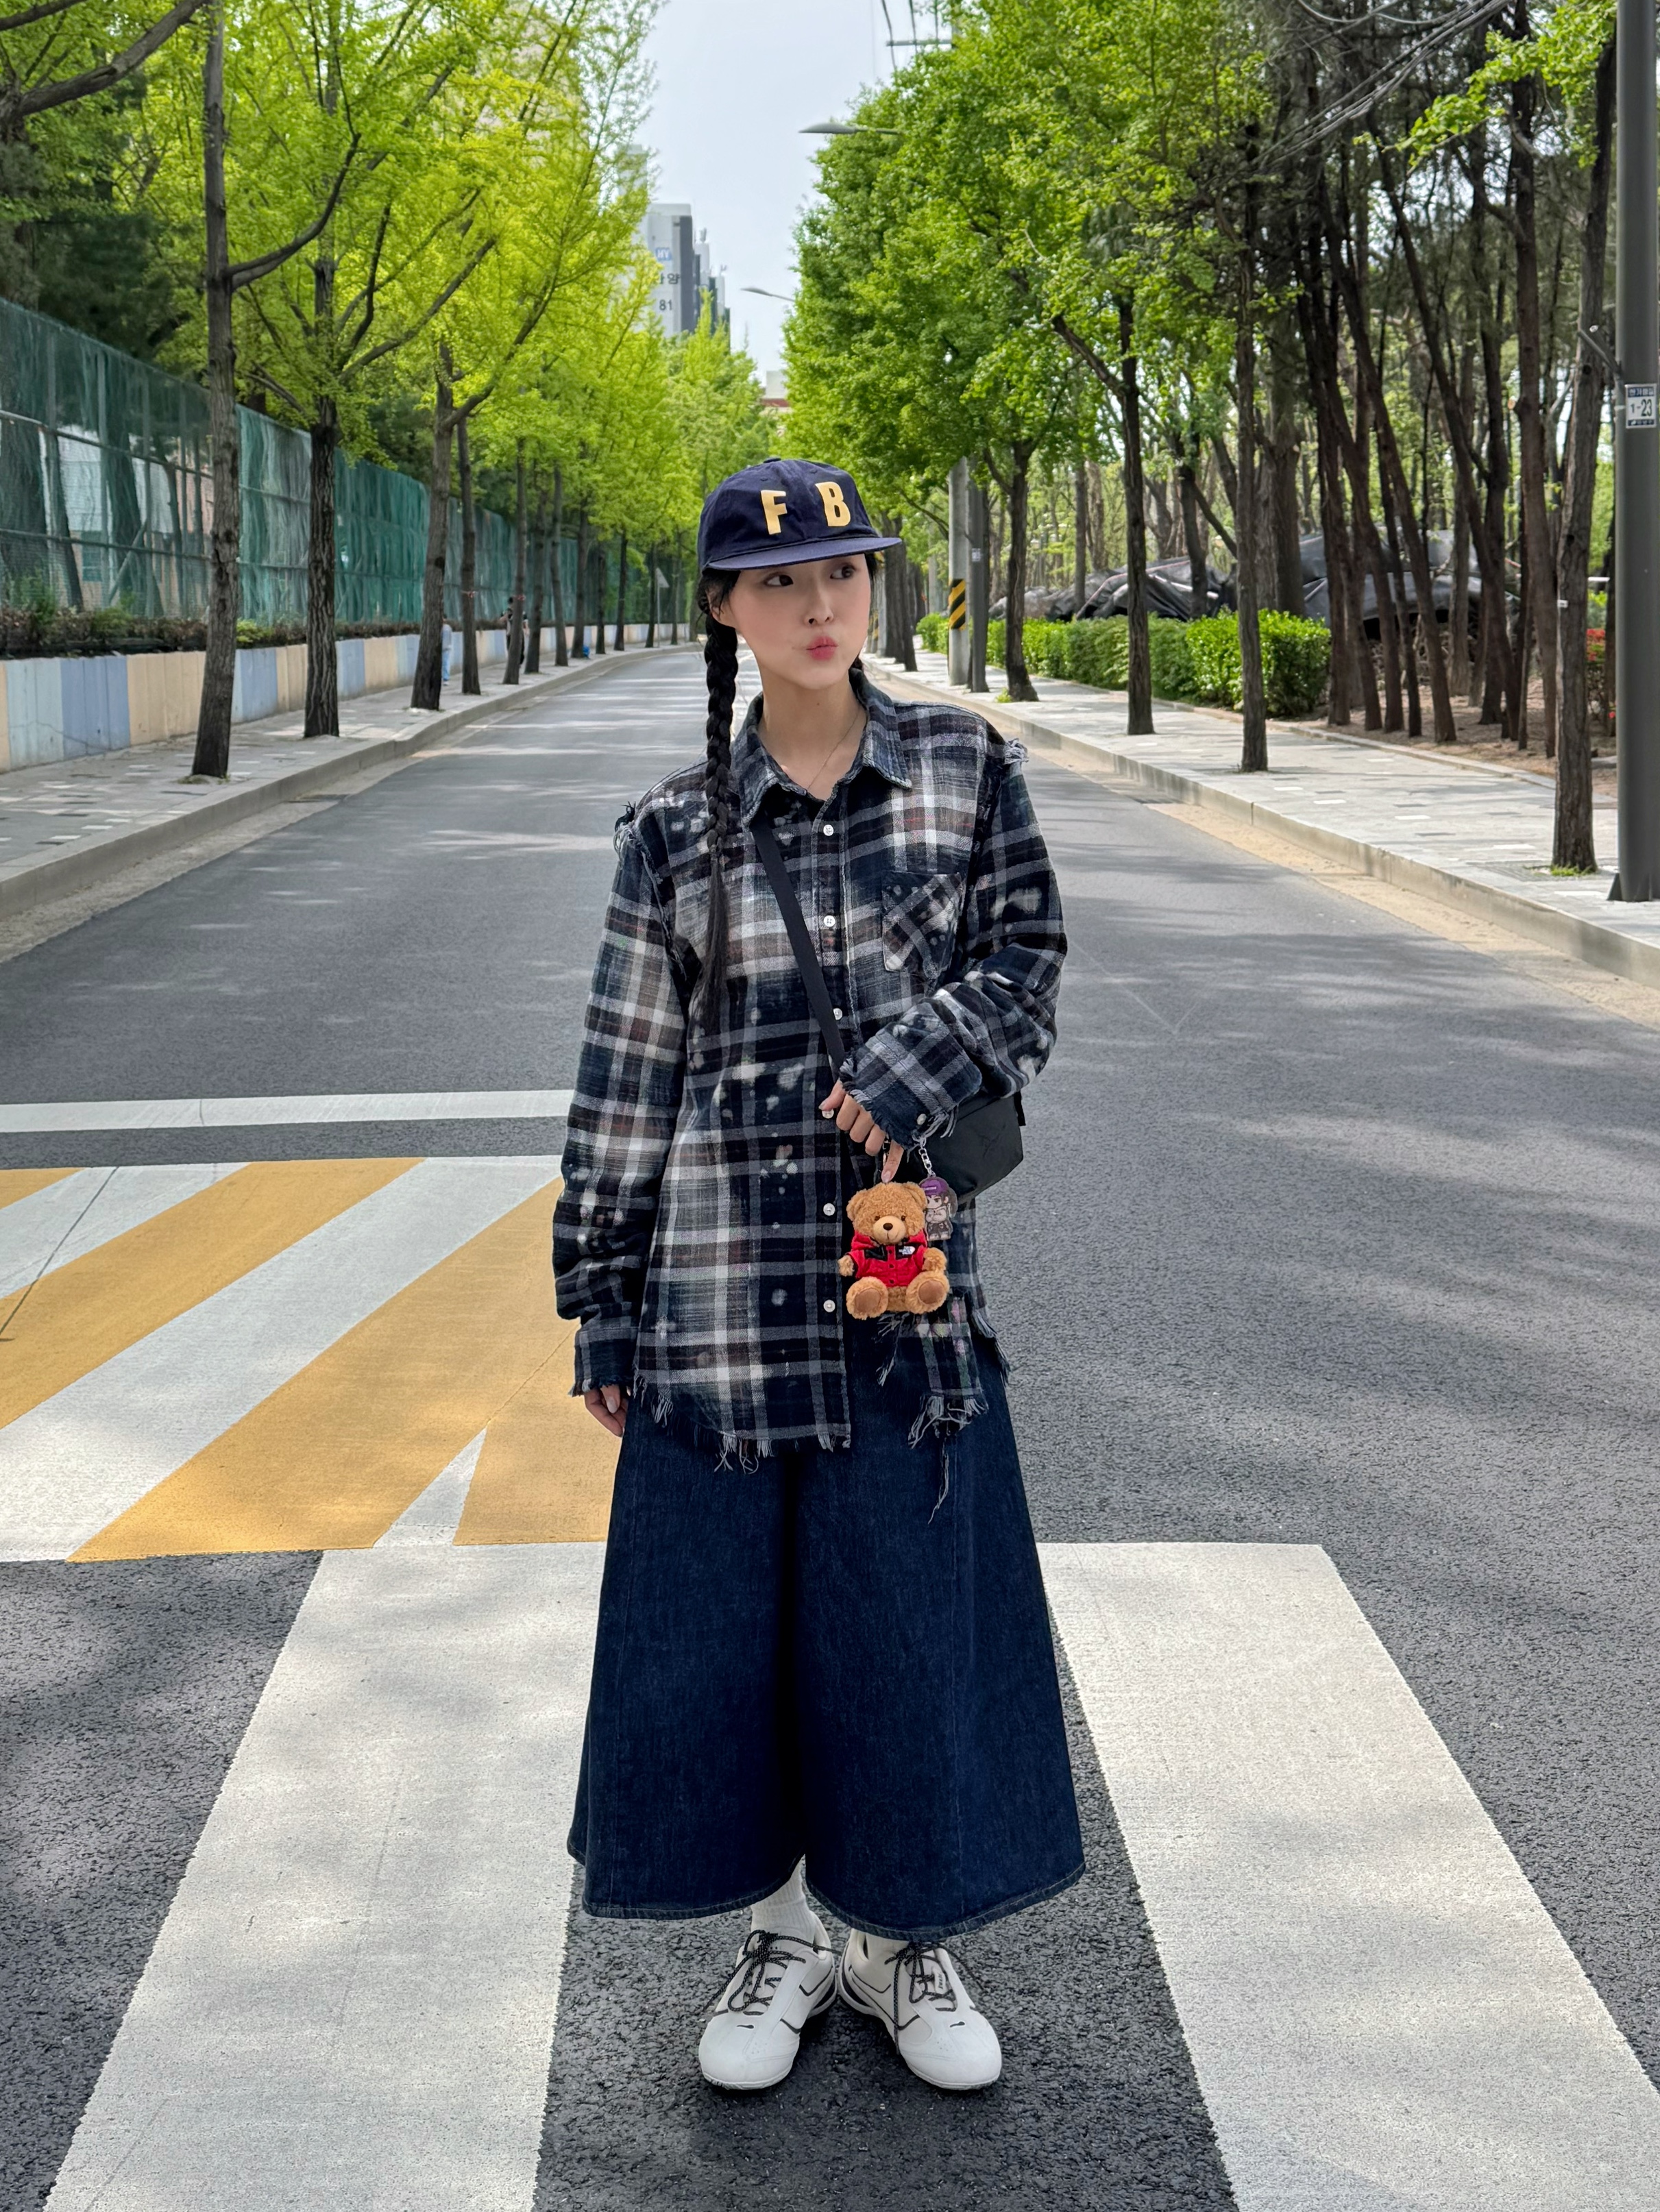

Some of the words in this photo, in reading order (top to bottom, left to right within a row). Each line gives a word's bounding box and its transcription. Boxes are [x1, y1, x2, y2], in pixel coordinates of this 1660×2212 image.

[659, 299, 673, 311] 81
[1631, 399, 1652, 417] 1-23
[760, 489, 788, 535] F
[815, 481, 851, 527] B
